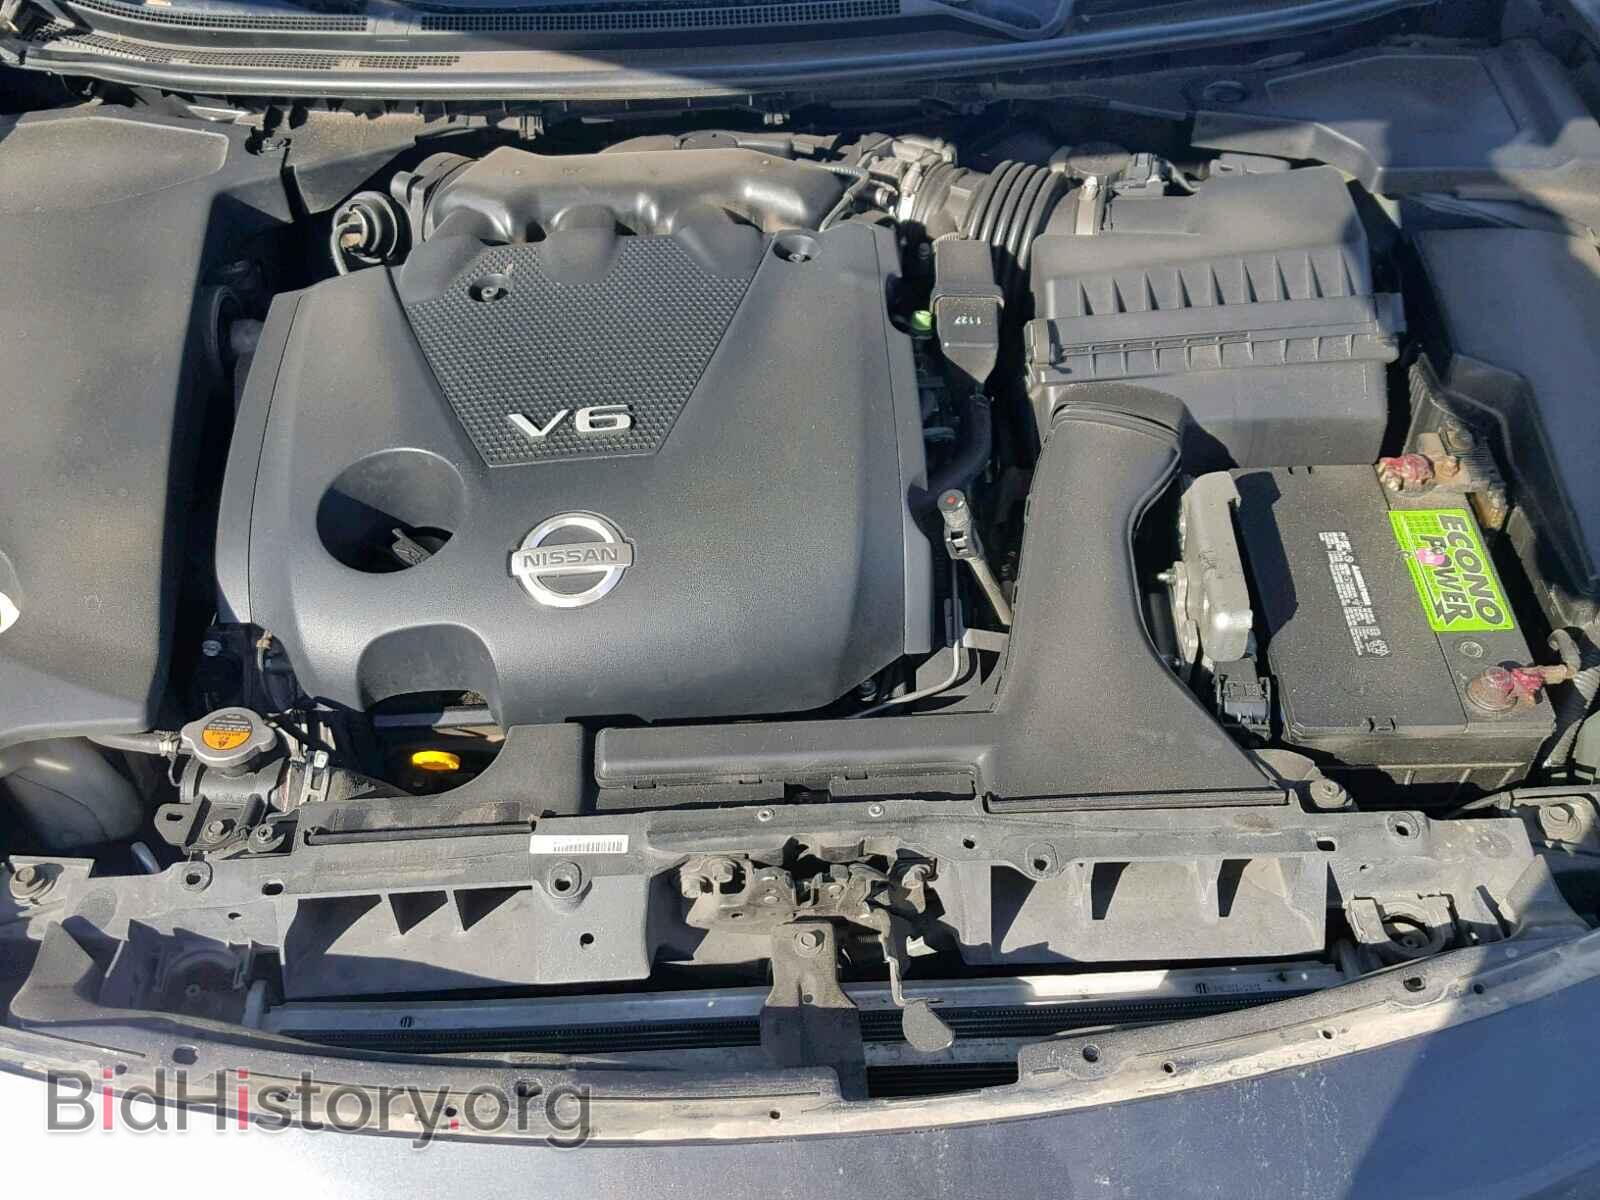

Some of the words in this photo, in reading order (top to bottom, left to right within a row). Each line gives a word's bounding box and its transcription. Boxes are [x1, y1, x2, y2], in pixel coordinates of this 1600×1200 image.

[508, 404, 632, 440] V6
[523, 548, 618, 568] NISSAN
[1438, 514, 1505, 624] ECONO
